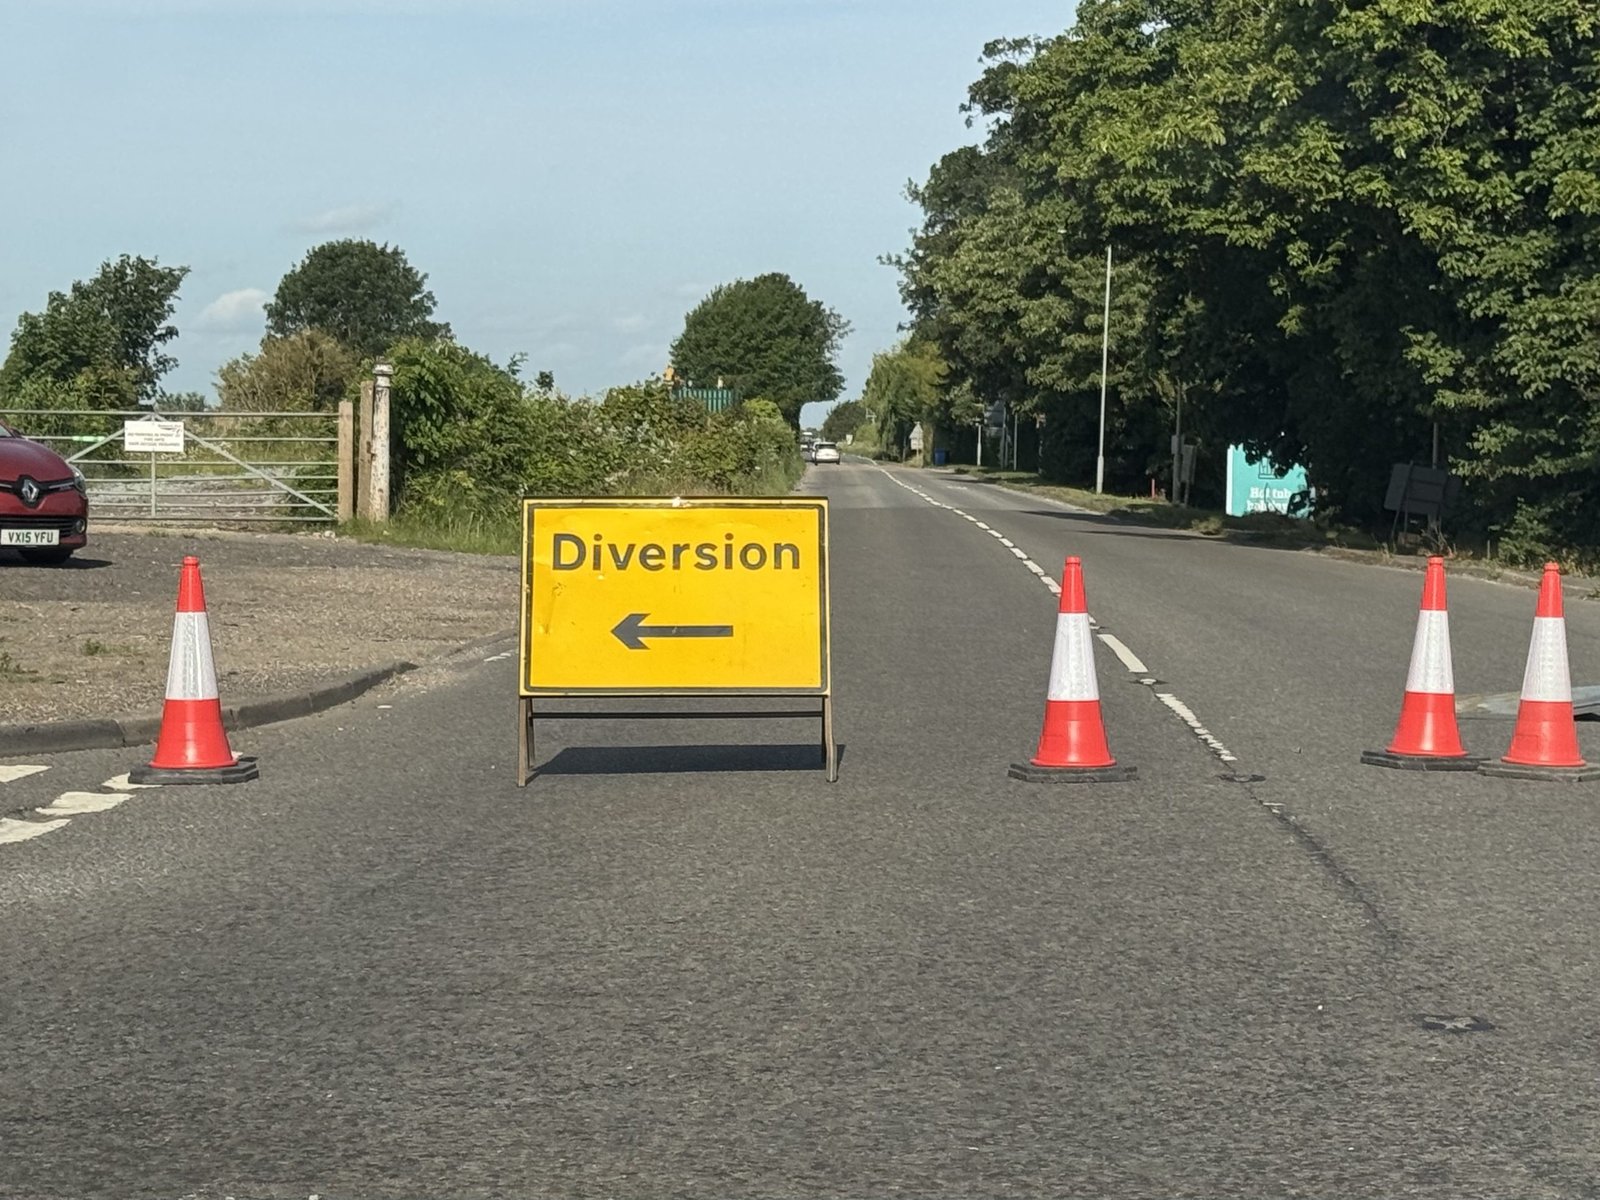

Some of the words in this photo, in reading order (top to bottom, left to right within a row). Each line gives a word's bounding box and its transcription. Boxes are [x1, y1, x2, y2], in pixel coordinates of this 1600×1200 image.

[8, 531, 31, 543] VX15
[34, 531, 54, 543] YFU
[552, 532, 800, 571] Diversion
